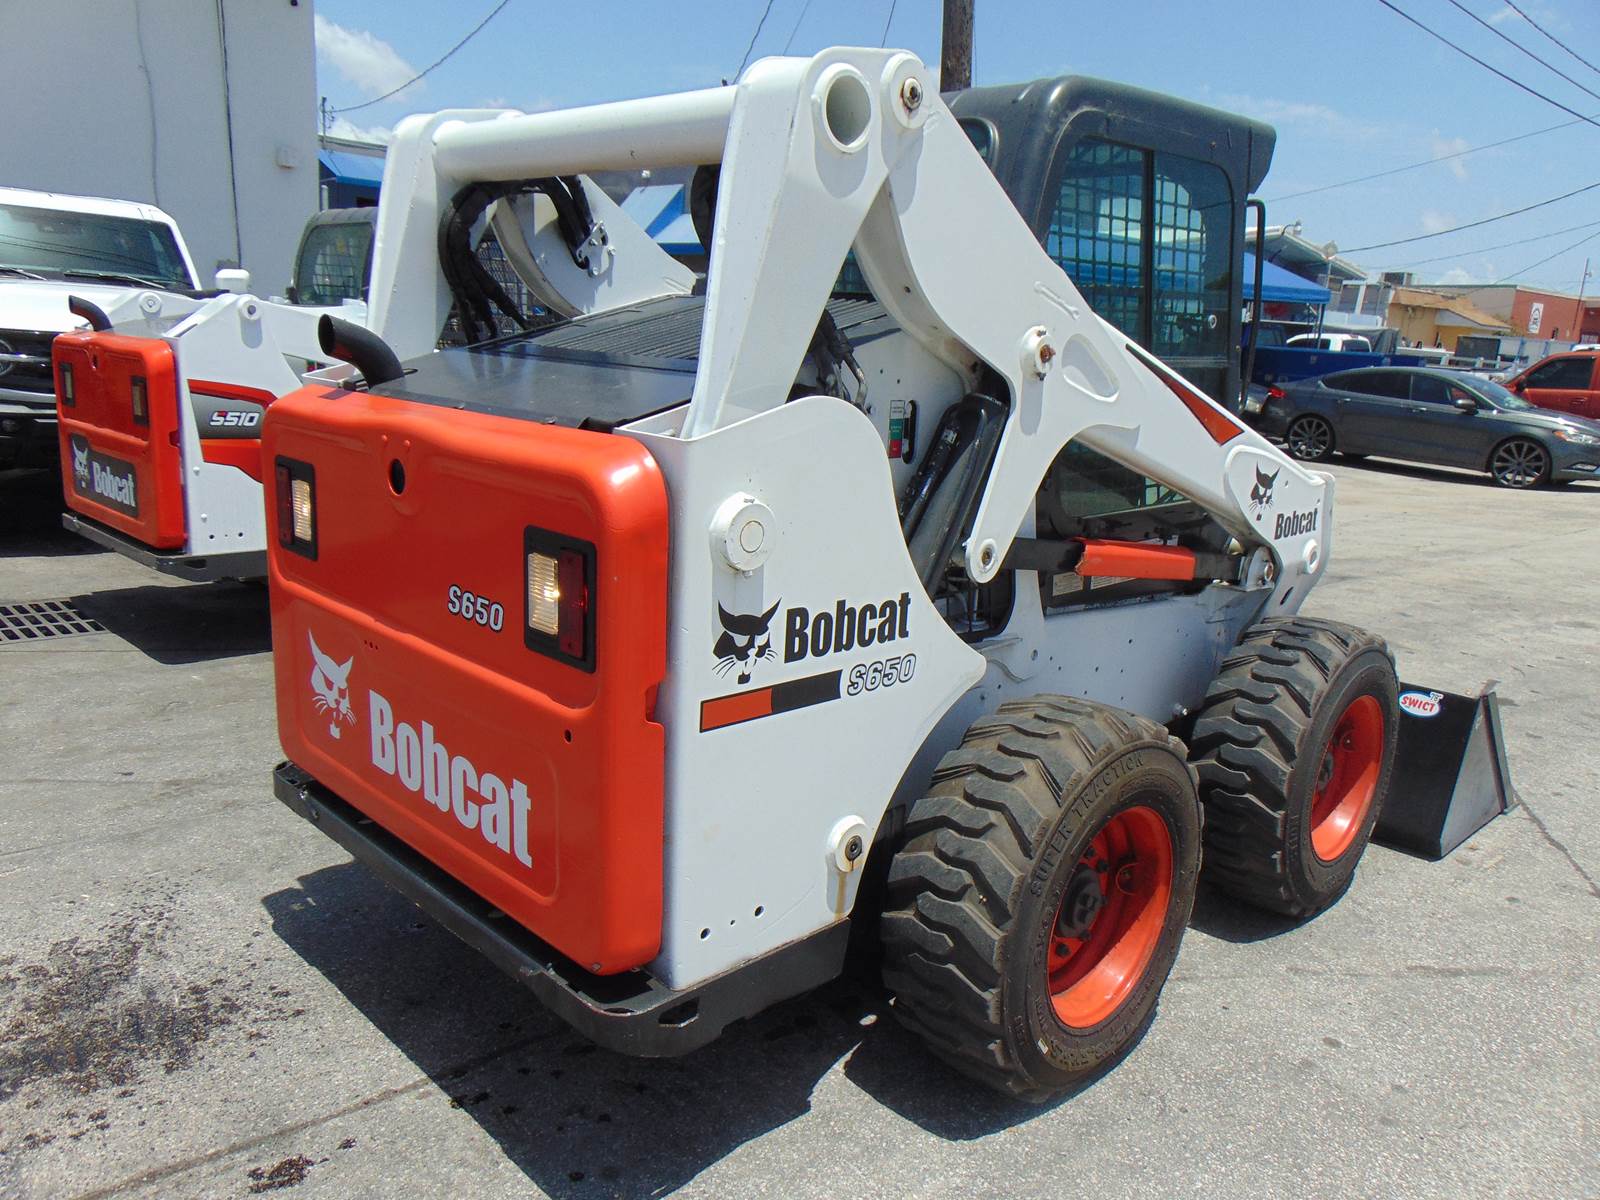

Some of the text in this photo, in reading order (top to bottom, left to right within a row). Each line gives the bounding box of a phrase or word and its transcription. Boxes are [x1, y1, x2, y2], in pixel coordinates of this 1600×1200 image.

[210, 411, 261, 428] S510
[92, 461, 136, 508] Bobcat
[1274, 507, 1319, 540] Bobcat
[447, 583, 505, 633] S650
[784, 591, 912, 664] Bobcat
[847, 653, 918, 697] S650
[369, 688, 534, 869] Bobcat
